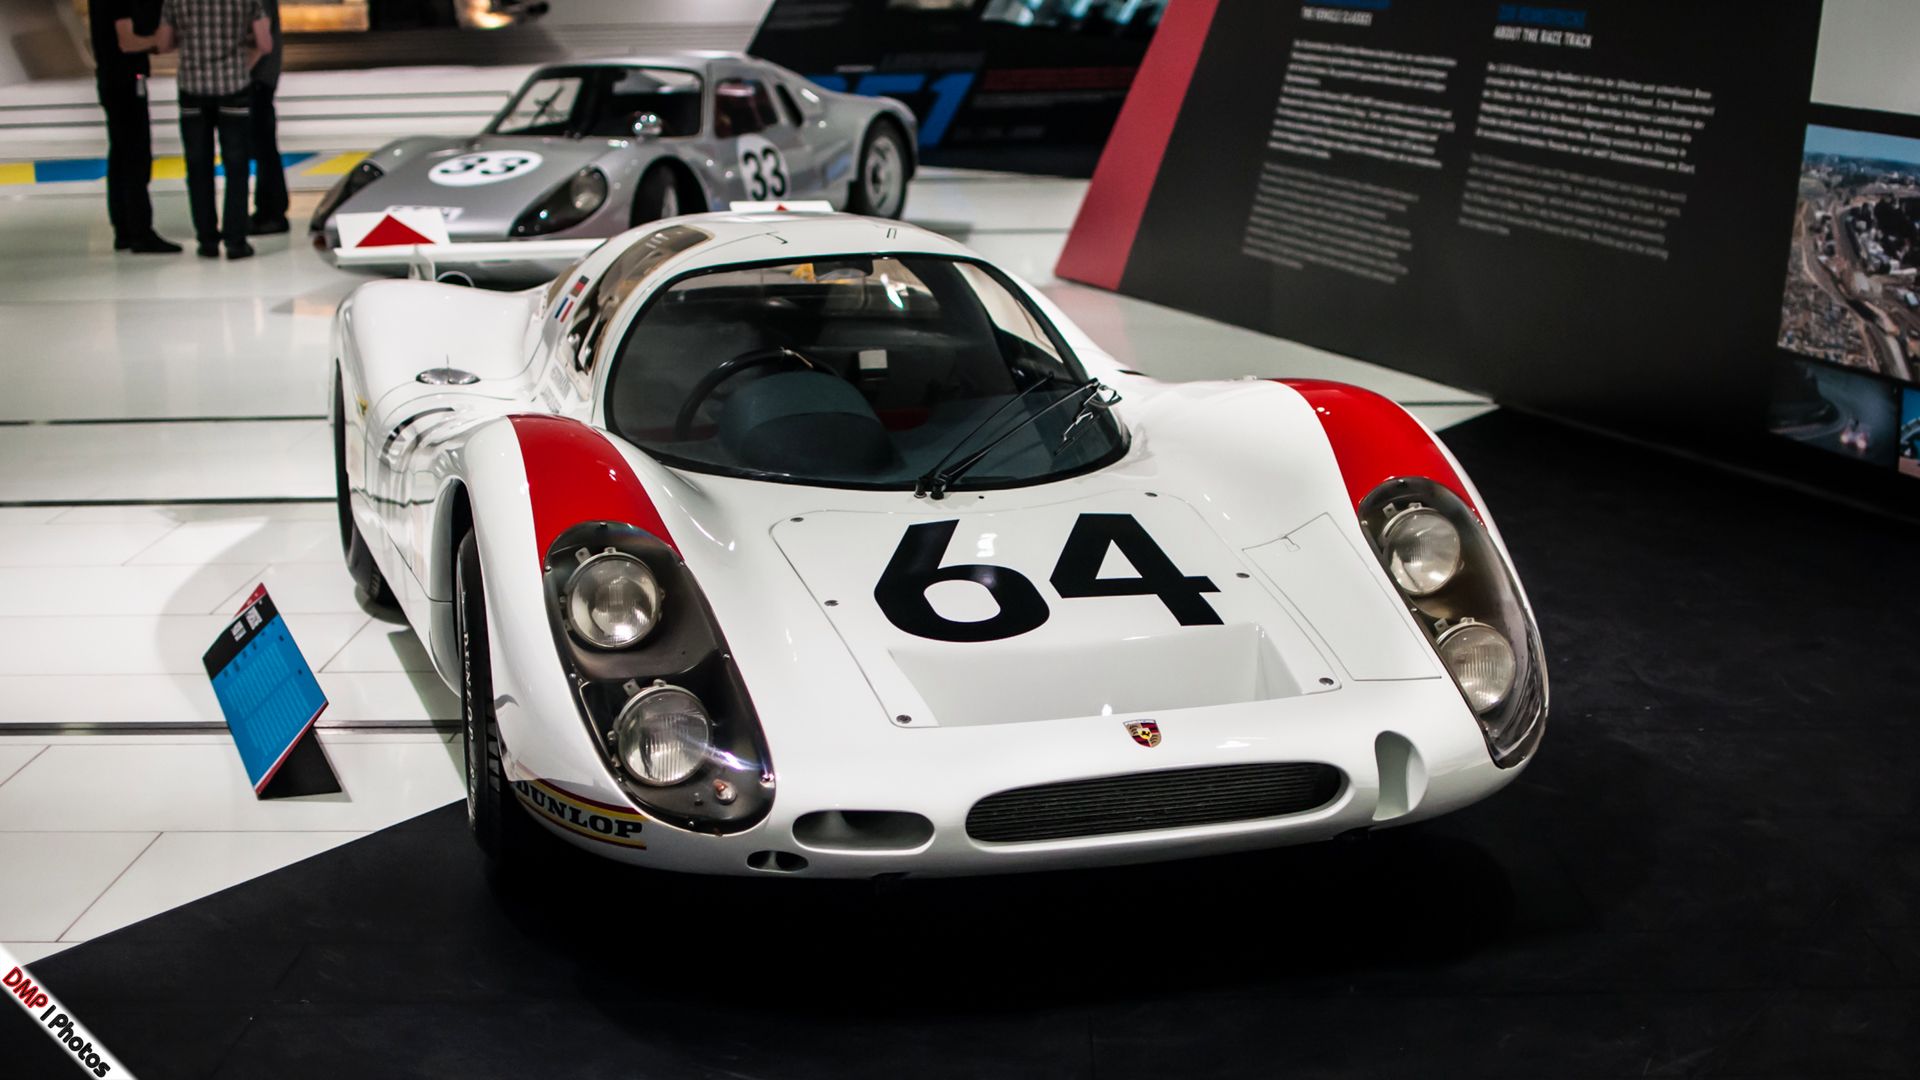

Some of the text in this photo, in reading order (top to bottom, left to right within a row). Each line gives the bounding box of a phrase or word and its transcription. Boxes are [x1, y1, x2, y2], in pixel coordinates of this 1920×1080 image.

[439, 155, 529, 175] 33
[743, 147, 787, 201] 33
[874, 512, 1224, 643] 64
[516, 781, 643, 838] DUNLOP
